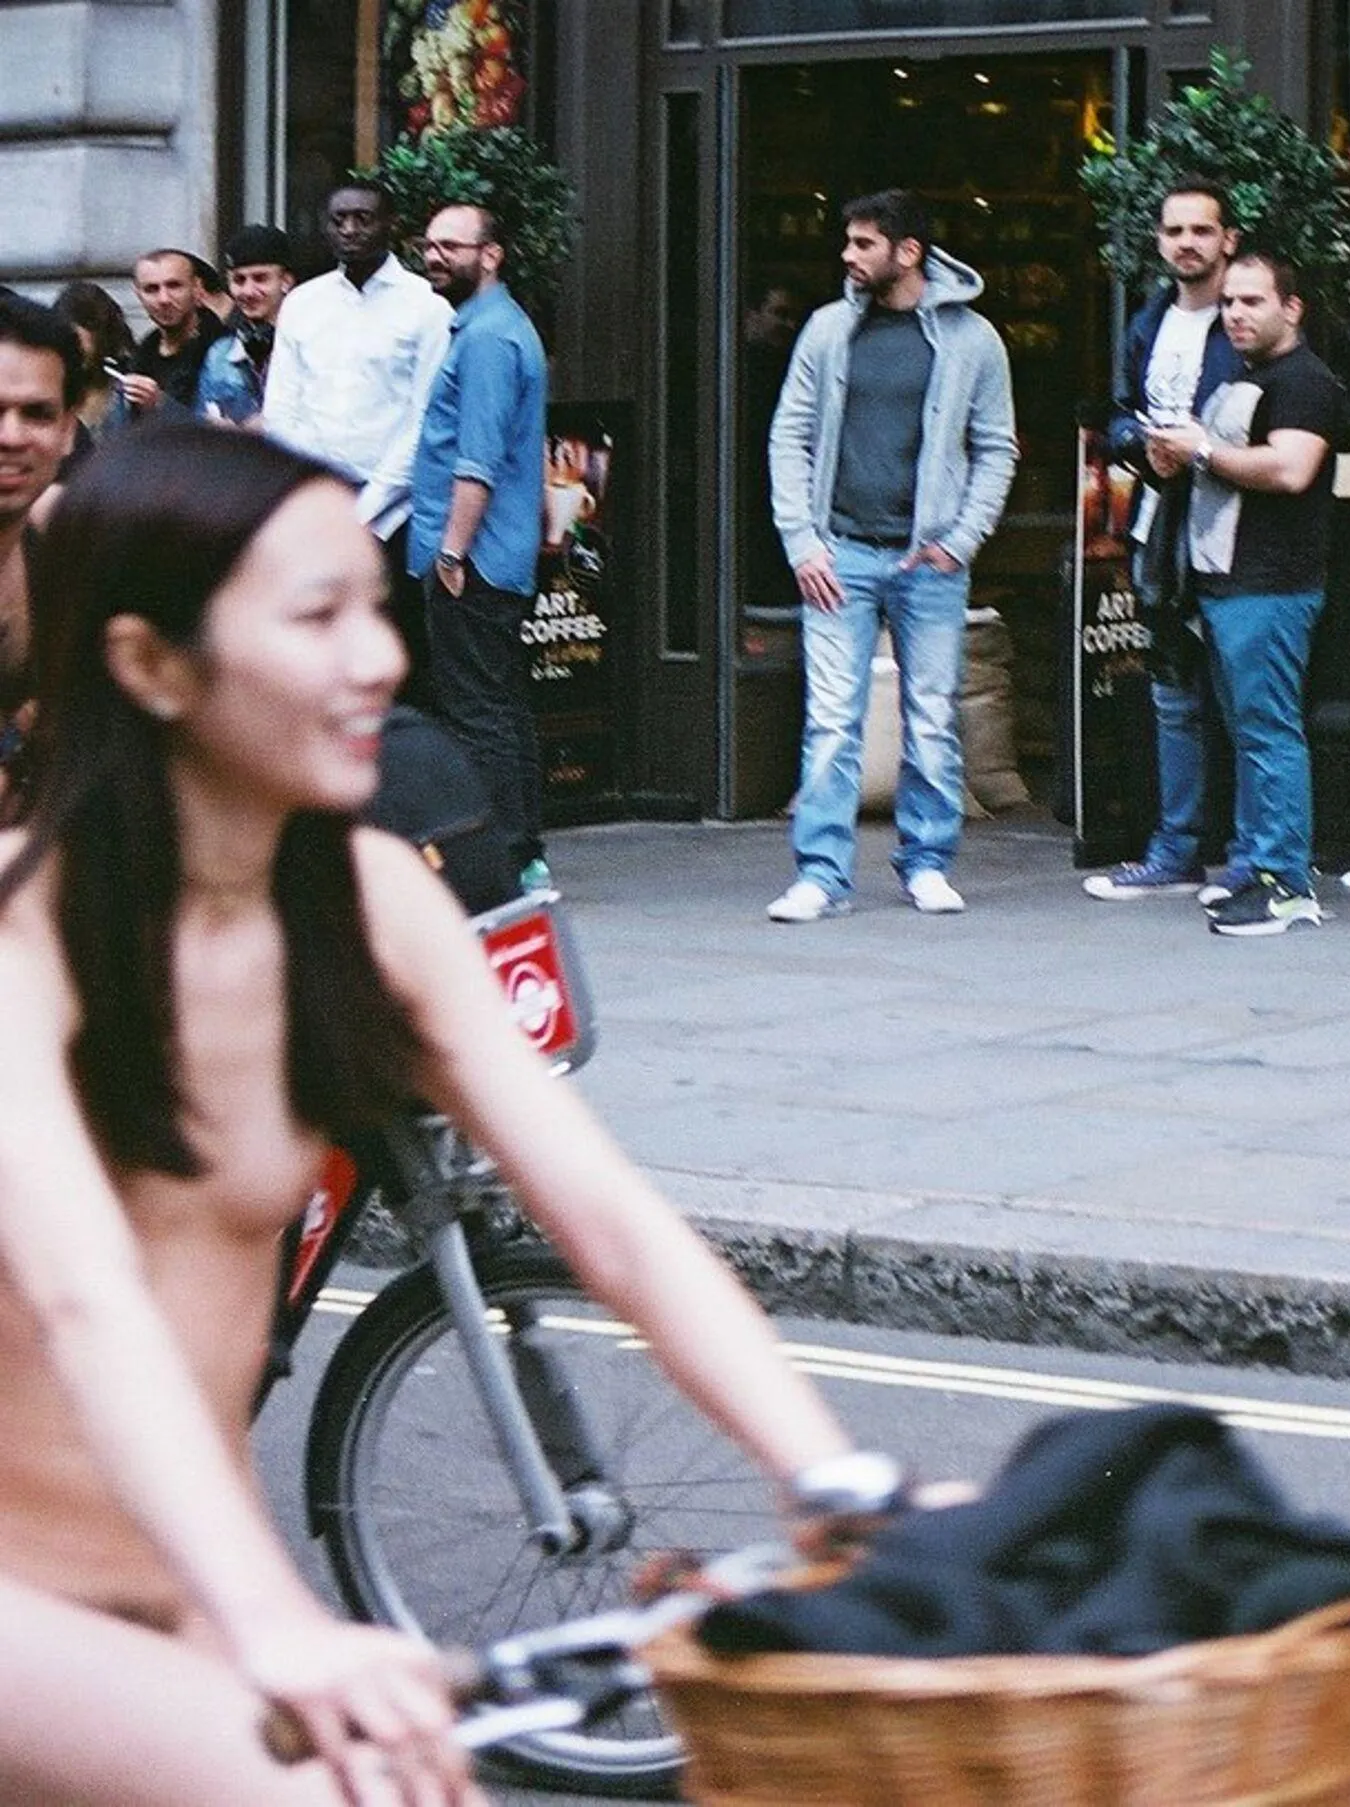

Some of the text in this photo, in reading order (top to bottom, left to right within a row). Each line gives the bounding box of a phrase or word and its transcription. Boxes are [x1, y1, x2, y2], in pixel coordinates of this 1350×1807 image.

[534, 590, 579, 616] ART
[1097, 592, 1135, 620] ART
[519, 614, 606, 644] COFFEE
